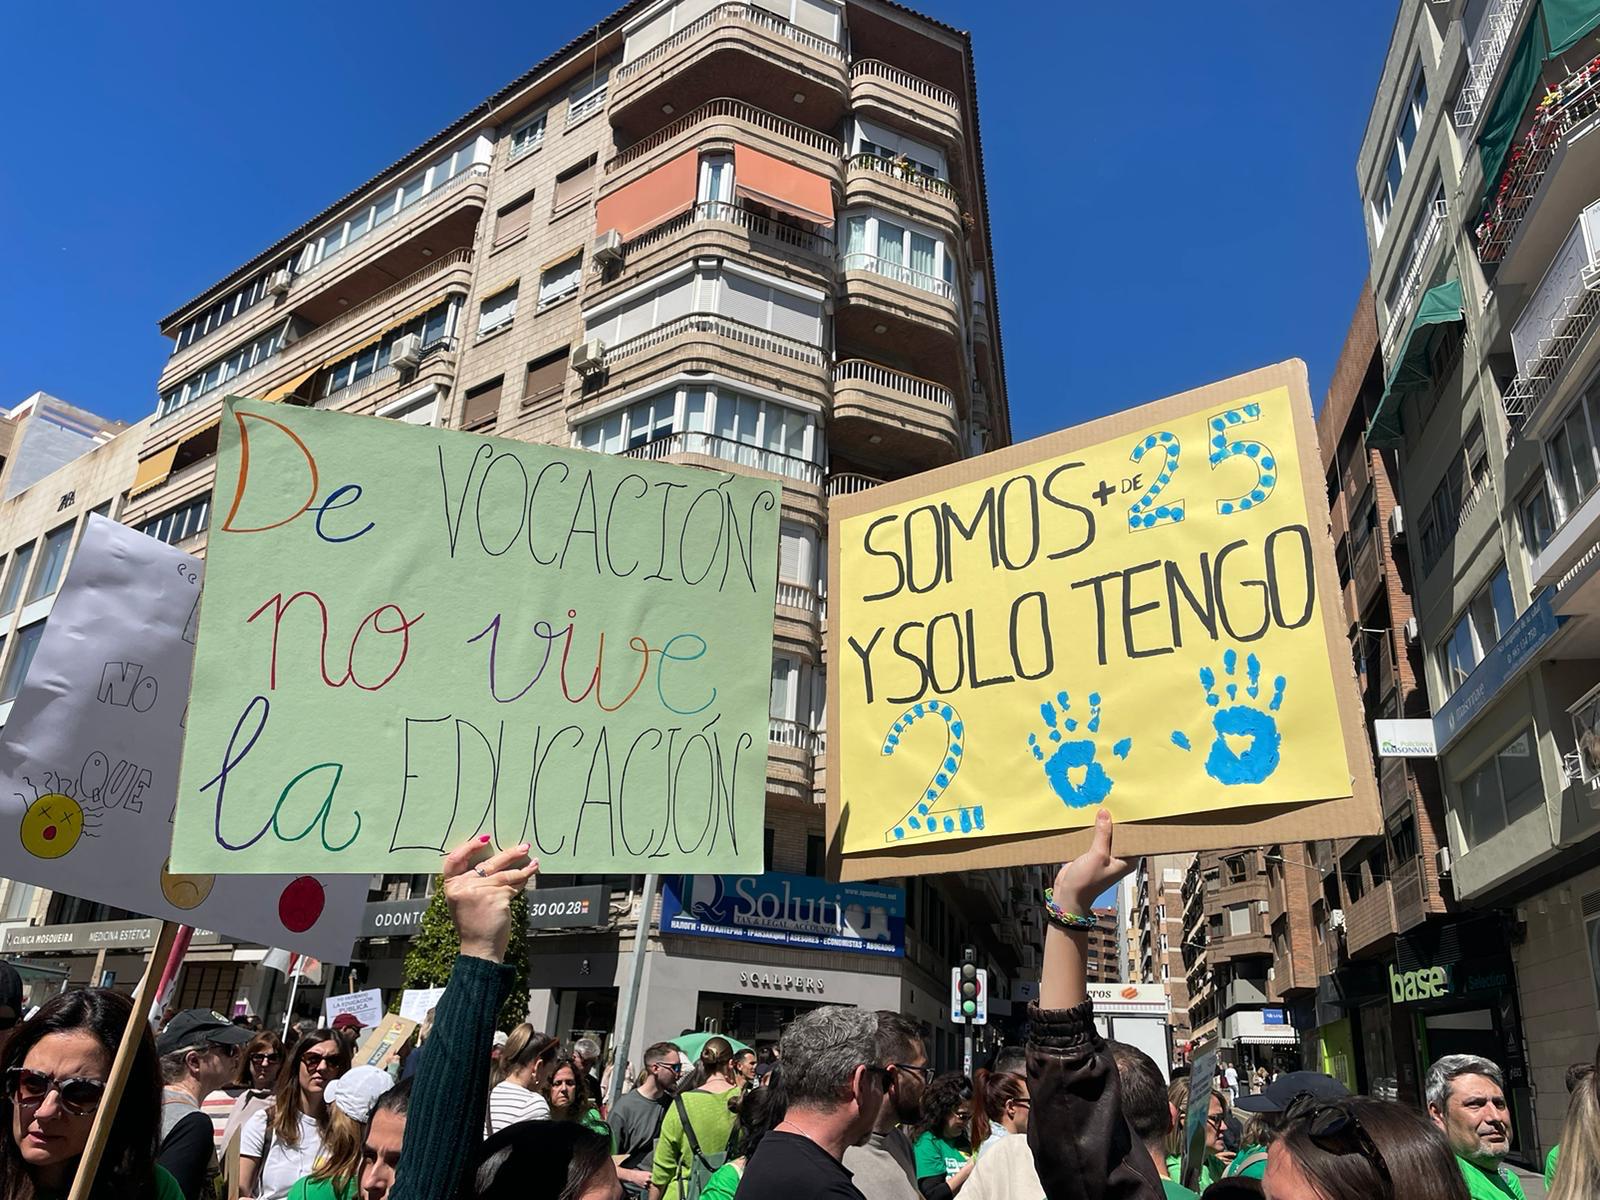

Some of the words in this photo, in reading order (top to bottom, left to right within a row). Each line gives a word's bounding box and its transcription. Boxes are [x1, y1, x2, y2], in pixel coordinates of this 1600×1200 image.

[221, 411, 376, 543] De
[438, 443, 775, 593] VOCACIÓN
[862, 461, 1096, 602] SOMOS
[1127, 401, 1279, 534] 25
[246, 590, 426, 692] no
[466, 609, 718, 714] vive
[1071, 524, 1315, 667] TENGO
[97, 661, 159, 713] NO
[80, 750, 153, 814] QUE
[199, 695, 361, 852] la
[389, 713, 753, 858] EDUCACIÓN
[879, 699, 986, 844] 2
[740, 970, 825, 990] SCALPERS
[1388, 963, 1450, 1004] base
